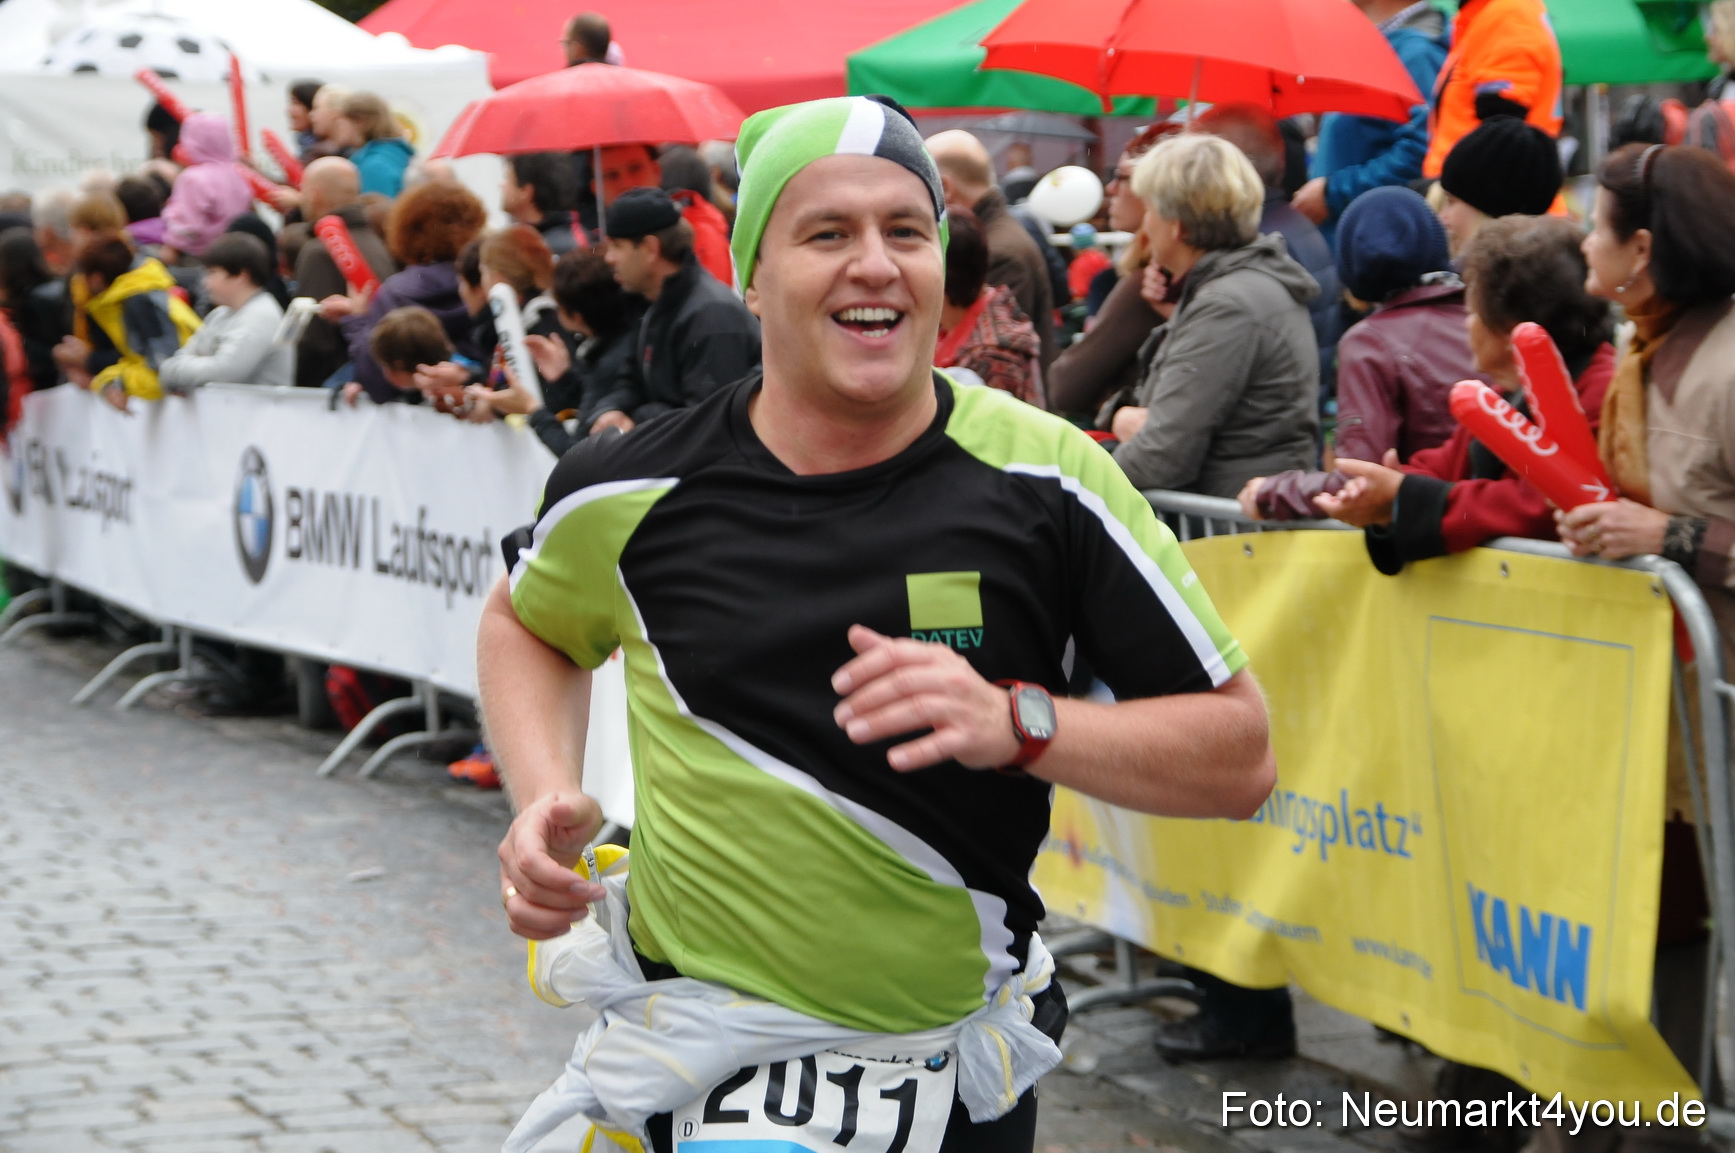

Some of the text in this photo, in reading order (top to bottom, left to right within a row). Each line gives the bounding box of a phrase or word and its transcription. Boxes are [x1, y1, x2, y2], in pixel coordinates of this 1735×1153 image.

[286, 487, 492, 611] BMW Laufsport
[911, 628, 984, 649] DATEV
[1466, 880, 1592, 1013] KANN
[702, 1054, 918, 1153] 2011
